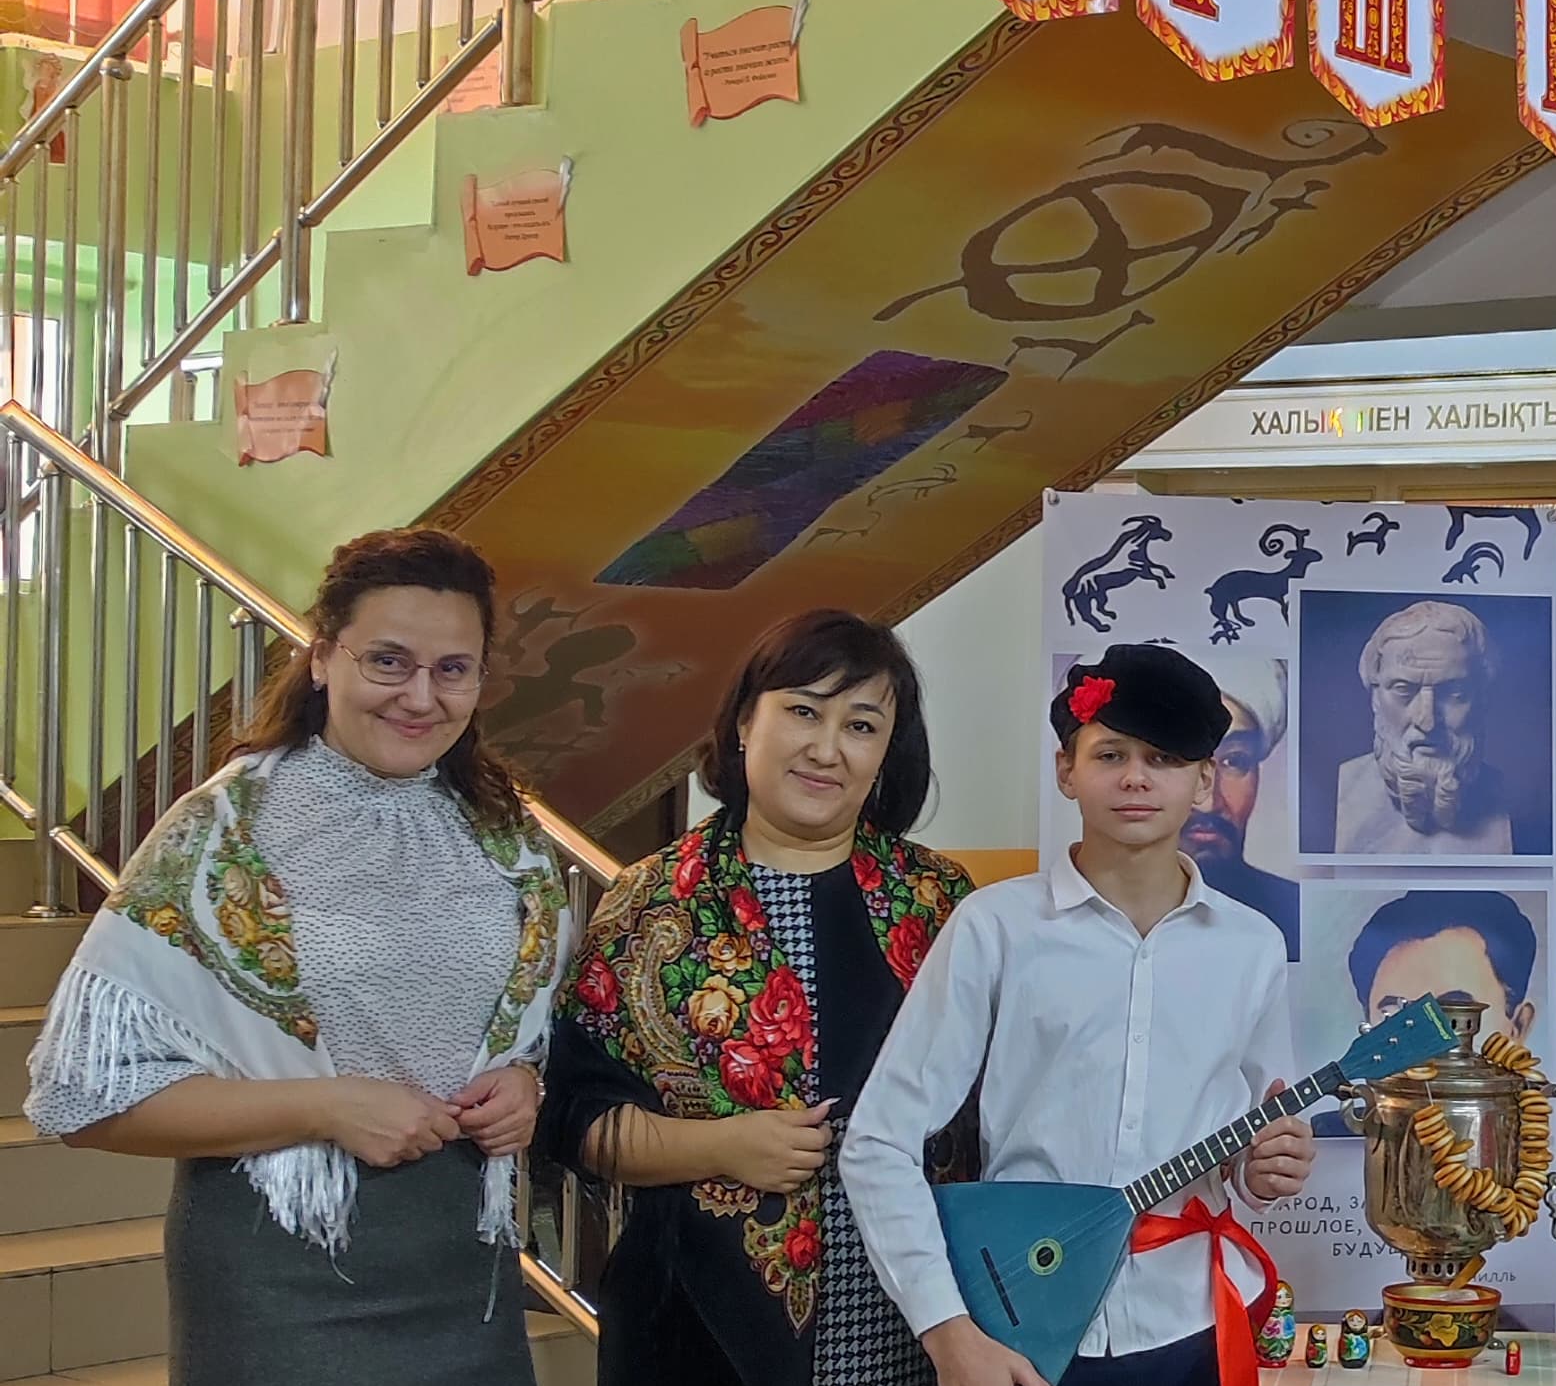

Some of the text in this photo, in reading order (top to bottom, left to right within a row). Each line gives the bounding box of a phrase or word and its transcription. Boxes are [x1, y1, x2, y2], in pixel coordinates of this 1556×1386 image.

[1250, 406, 1343, 438] ХАЛЫҚ
[1272, 1196, 1341, 1213] РОД,
[1250, 1219, 1362, 1236] ПРОШЛОЕ,
[1474, 1271, 1517, 1283] ИЛЛЬ
